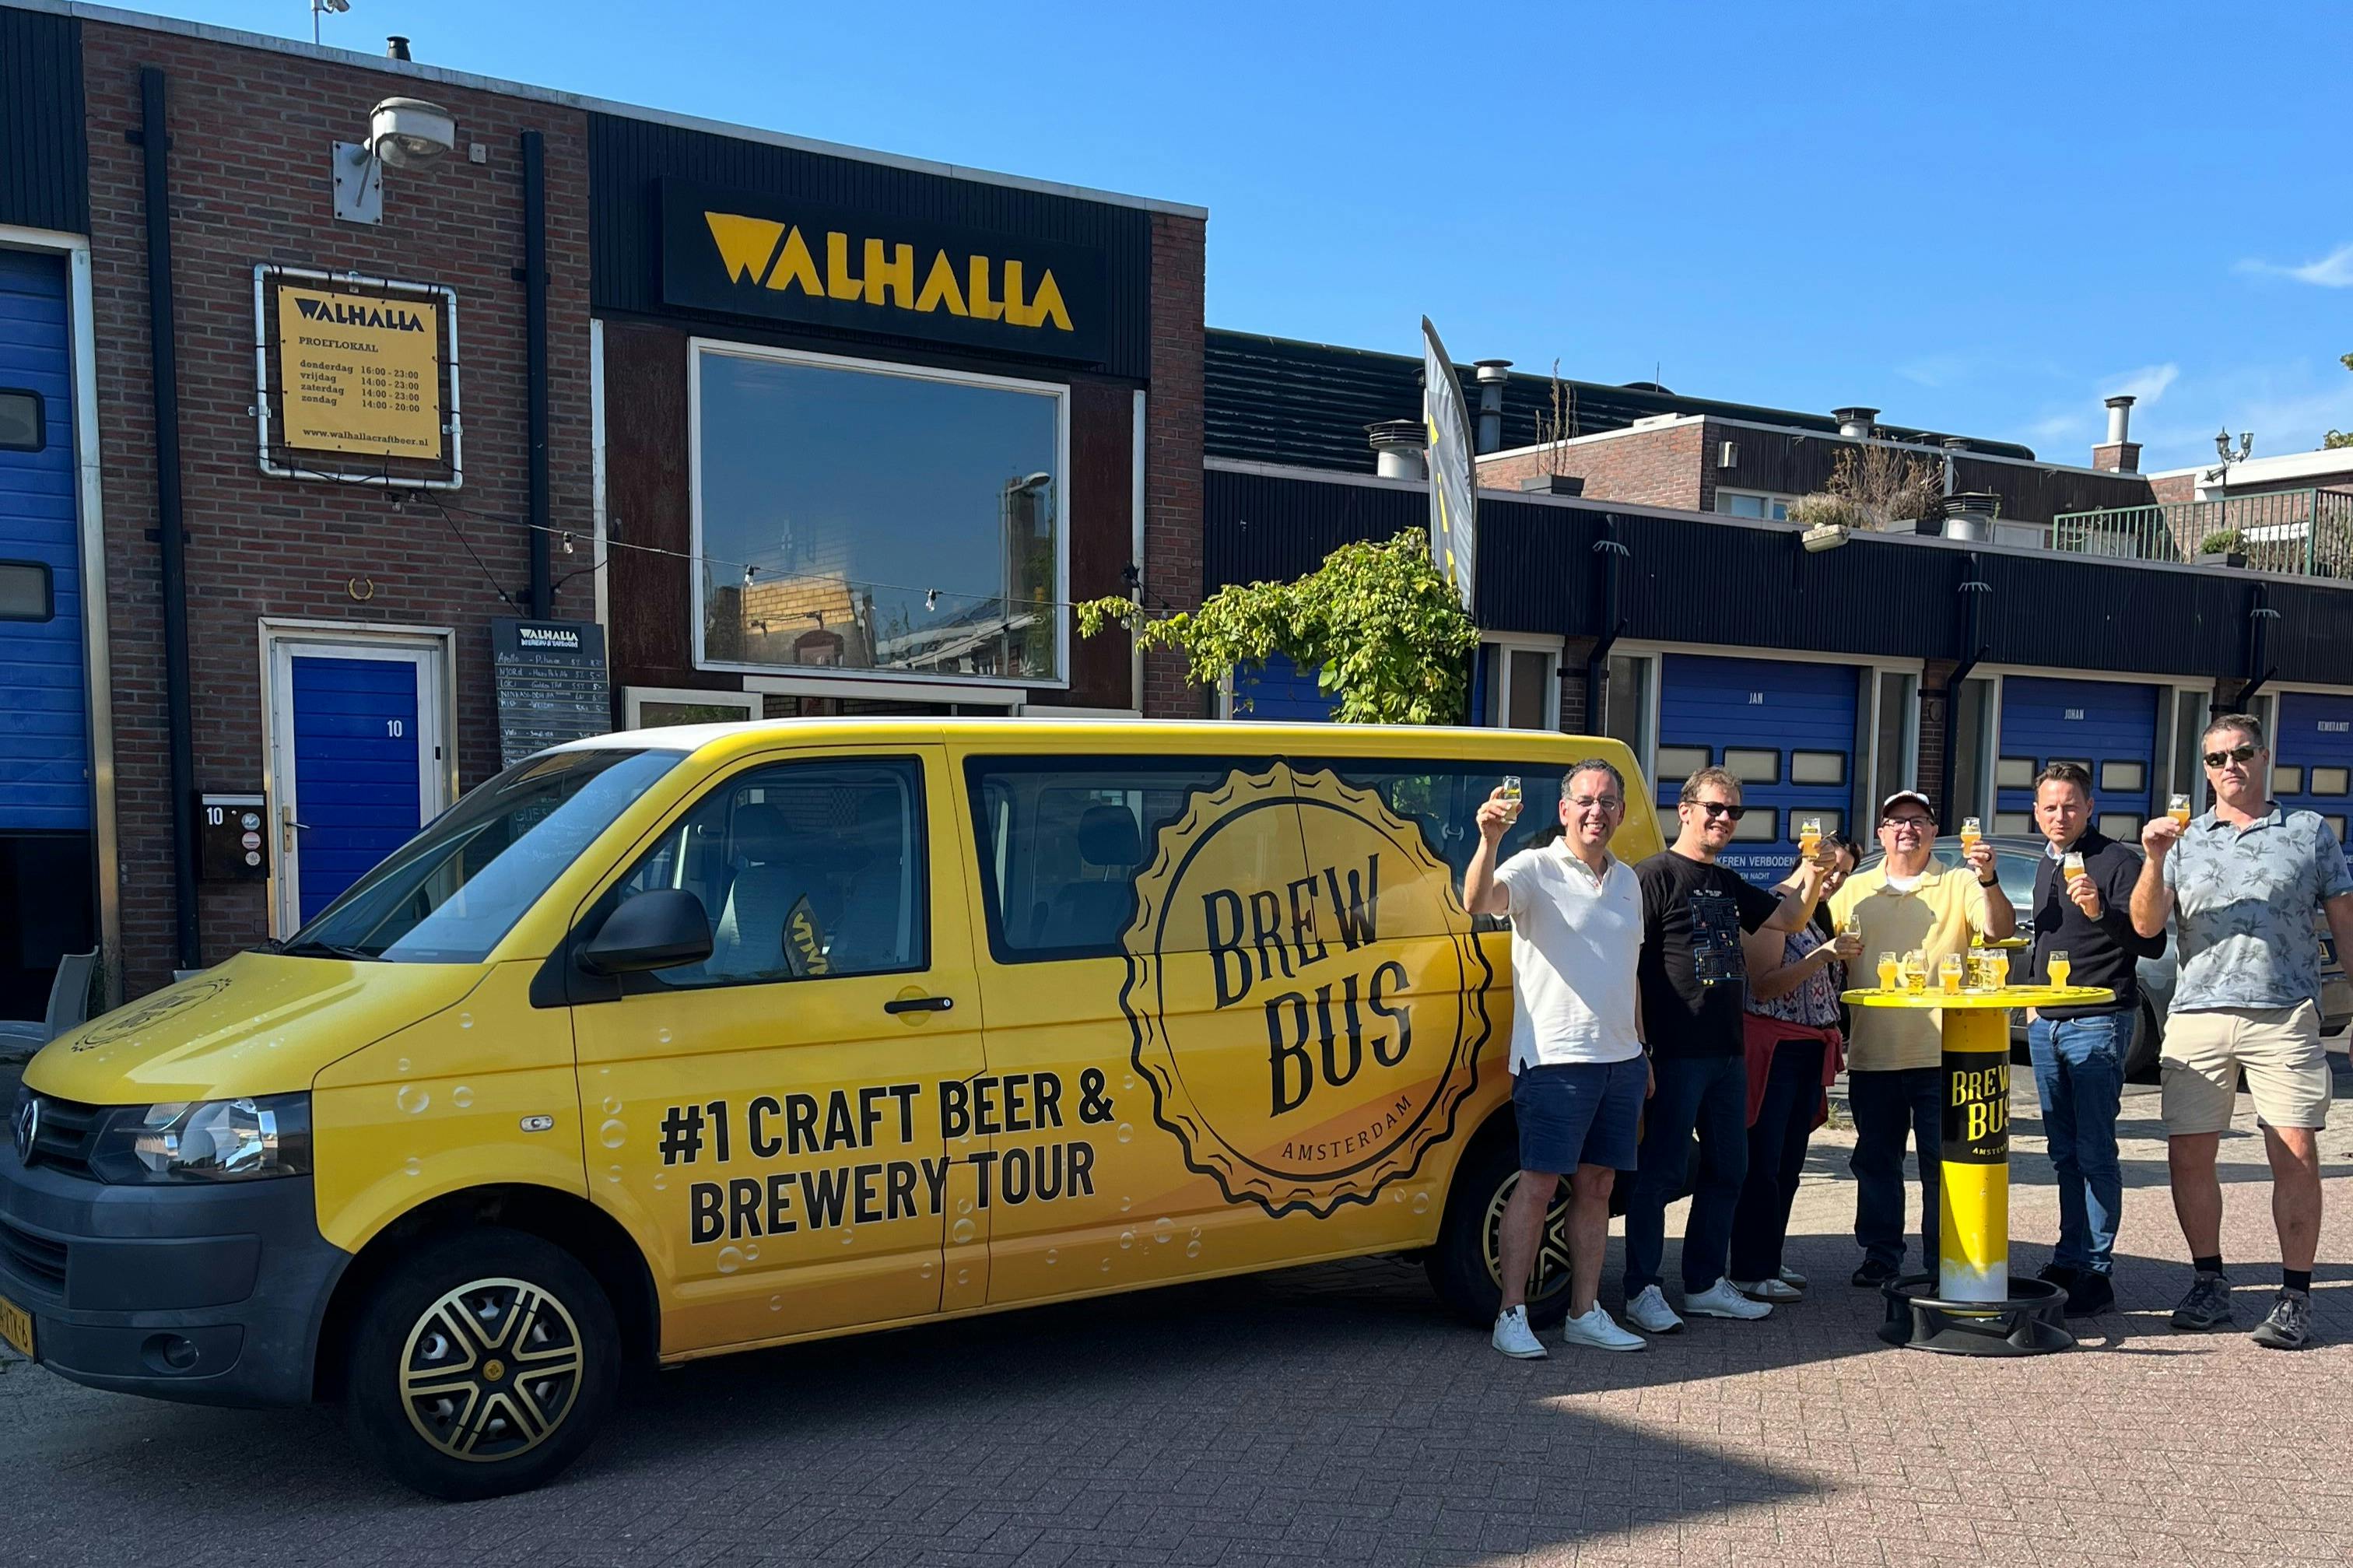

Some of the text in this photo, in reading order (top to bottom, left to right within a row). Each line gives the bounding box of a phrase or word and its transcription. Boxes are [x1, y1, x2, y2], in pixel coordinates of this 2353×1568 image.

[704, 210, 1075, 332] WALHALLA
[294, 297, 425, 333] WALHALLA
[299, 335, 379, 353] PROEFLOKAAL
[300, 360, 354, 374] donderdag
[361, 366, 386, 377] 16:00
[394, 370, 419, 380] 23:00
[300, 372, 337, 384] vrijdag
[361, 377, 387, 388] 14:00
[394, 381, 419, 391] 23:00
[300, 384, 345, 396] zaterdag
[362, 388, 387, 398] 14:00
[395, 391, 419, 402] 23:00
[301, 395, 338, 406] zondag
[362, 399, 387, 409] 14:00
[395, 403, 420, 412] 20:00
[303, 428, 429, 447] www.walhallacraftbeer.nl
[520, 629, 578, 641] WALHALLA
[1748, 692, 1763, 704] JAN
[2064, 709, 2085, 720] JOHAN
[387, 719, 402, 738] 10
[206, 807, 223, 825] 10
[1749, 856, 1796, 868] VERBODEN
[1201, 853, 1380, 1011] BREW
[1264, 960, 1413, 1118] BUS
[658, 1067, 1116, 1166] #1 CRAFT BEER &
[1281, 1094, 1413, 1162] AMSTERDAM
[689, 1140, 1096, 1245] BREWERY TOUR
